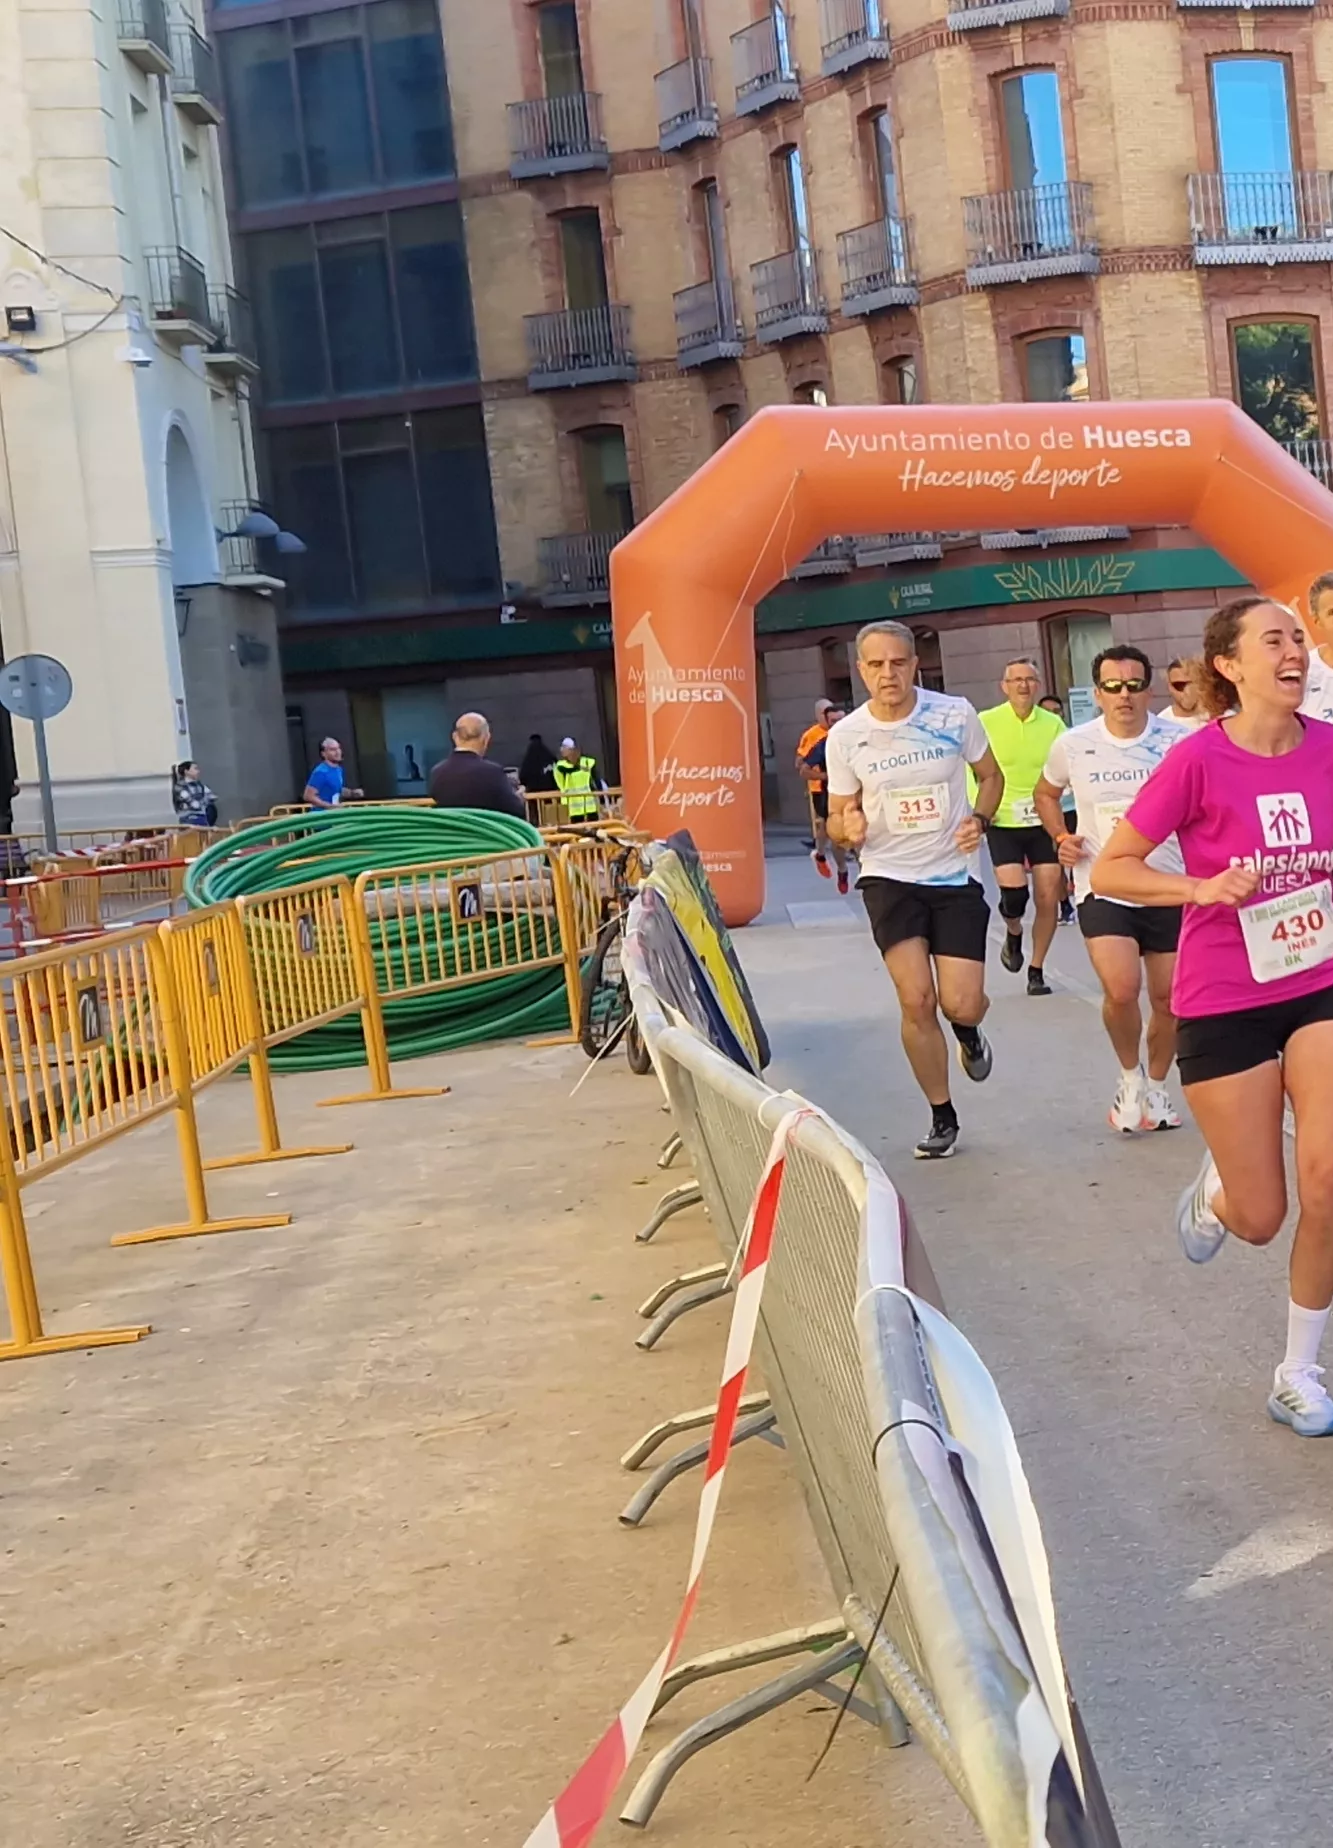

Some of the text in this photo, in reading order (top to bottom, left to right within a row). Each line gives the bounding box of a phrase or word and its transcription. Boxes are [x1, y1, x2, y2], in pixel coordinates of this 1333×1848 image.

[825, 425, 1191, 458] Ayuntamiento de Huesca
[899, 455, 1122, 499] Hacemos deporte
[628, 665, 745, 687] Ayuntamiento
[629, 685, 724, 704] de Huesca
[880, 747, 945, 771] COGITIAR
[656, 758, 744, 784] Hacemos
[1102, 767, 1151, 782] COGITI
[658, 784, 735, 818] deporte
[899, 797, 936, 814] 313
[703, 862, 732, 871] esca
[1271, 909, 1324, 942] 430
[1287, 936, 1318, 953] INES
